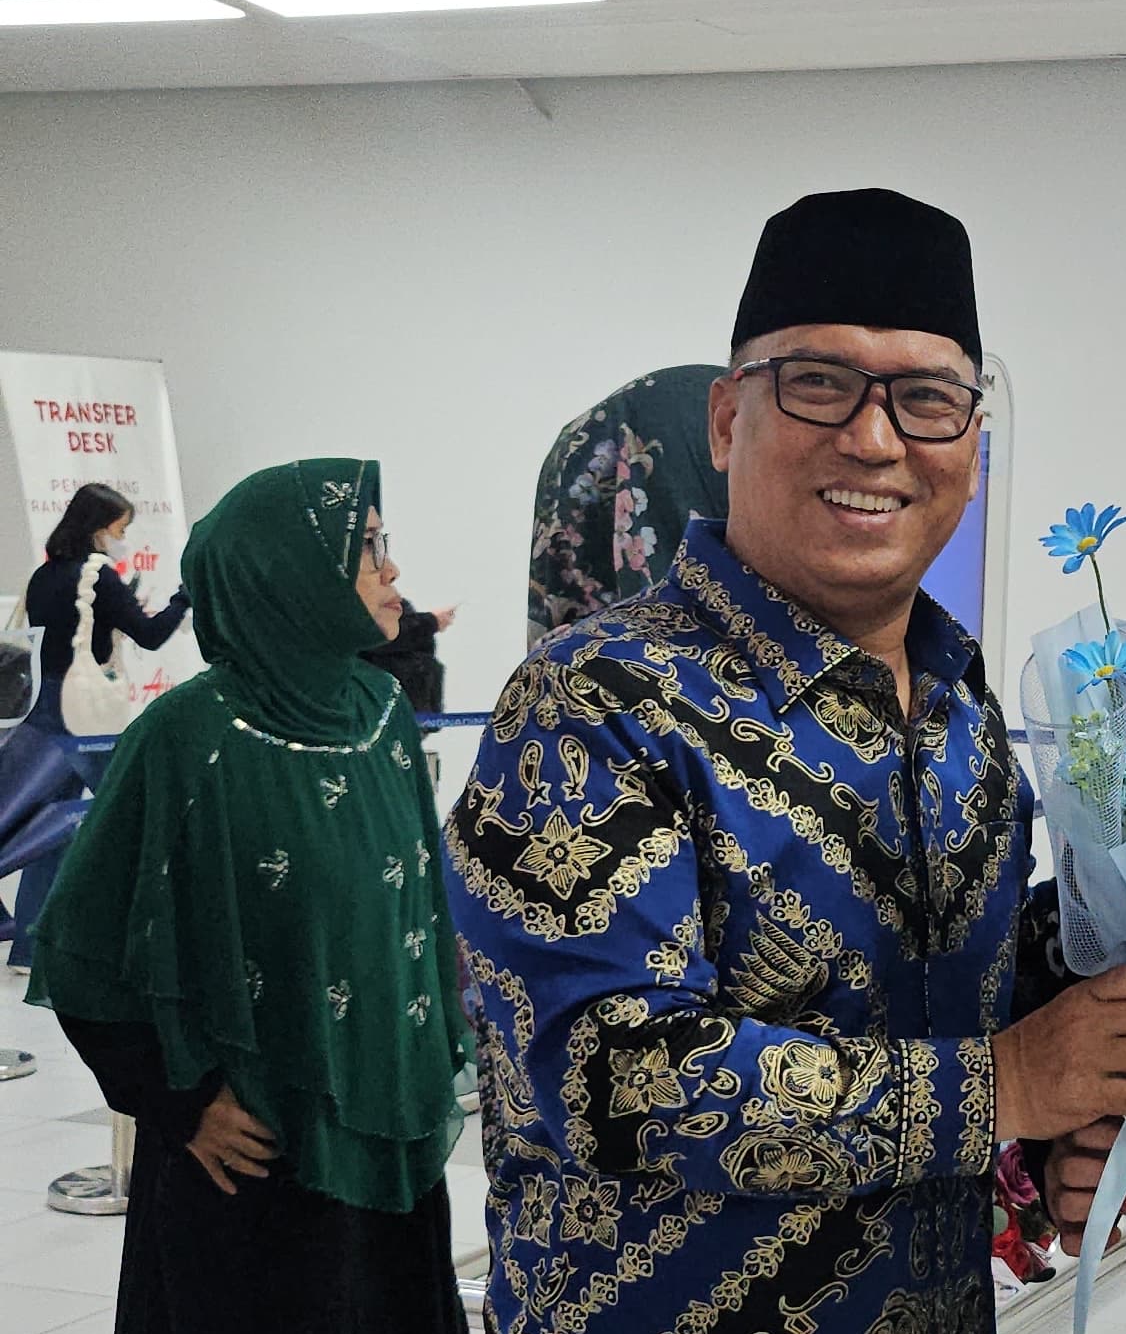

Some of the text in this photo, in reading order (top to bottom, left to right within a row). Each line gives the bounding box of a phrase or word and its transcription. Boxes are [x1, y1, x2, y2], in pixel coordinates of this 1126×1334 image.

[34, 400, 138, 426] TRANSFER
[67, 431, 118, 454] DESK
[133, 546, 159, 571] air
